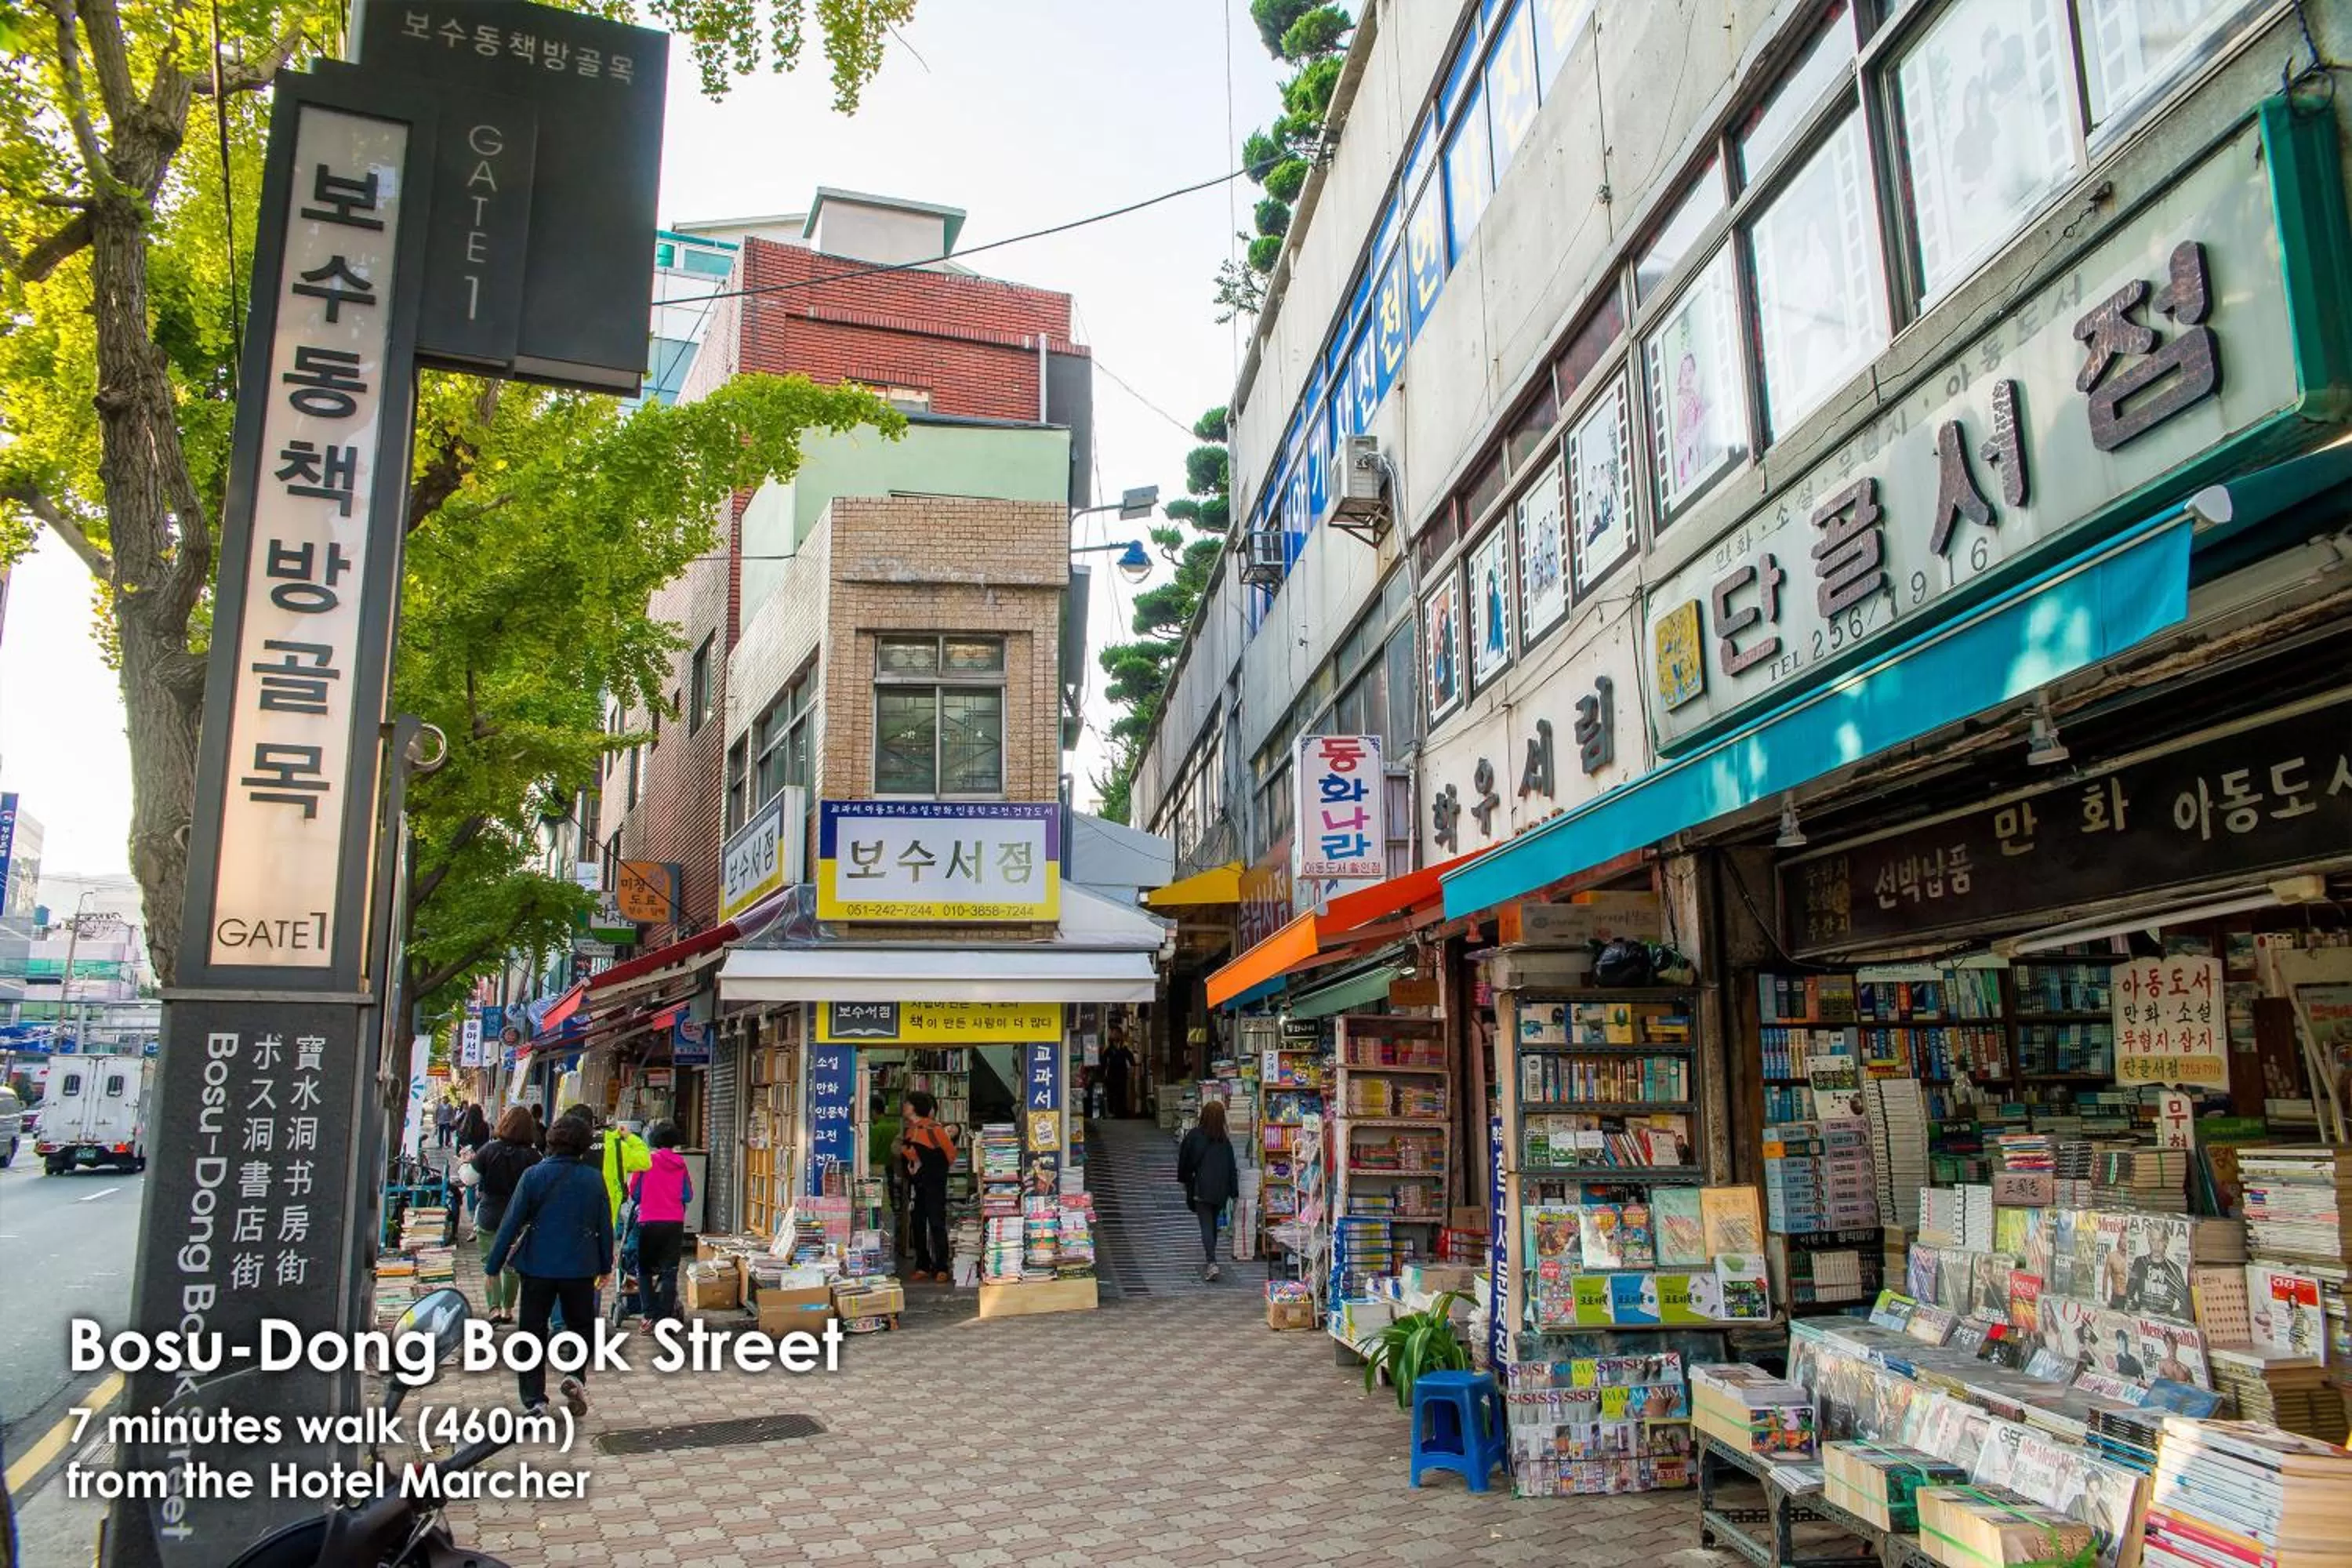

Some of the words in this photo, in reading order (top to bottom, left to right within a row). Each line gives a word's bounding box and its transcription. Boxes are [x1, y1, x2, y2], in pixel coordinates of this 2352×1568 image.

[401, 11, 634, 85] 보수동책방골목
[466, 125, 503, 264] GATE
[1711, 240, 2223, 677] 단골서점
[241, 163, 384, 820] 보수동책방골목
[1768, 650, 1803, 681] TEL
[1432, 674, 1614, 854] 학우서림
[1318, 737, 1372, 861] 동화나라
[728, 823, 775, 898] 보수서점
[846, 839, 1033, 884] 보수서점
[1305, 862, 1347, 874] 아동도서
[216, 913, 327, 950] GATE1
[2122, 963, 2212, 1003] 아동도서
[837, 1005, 891, 1018] 보수서점
[816, 1056, 839, 1071] 소설
[816, 1081, 839, 1095] 만화
[1034, 1045, 1053, 1109] 교과서
[2122, 1058, 2178, 1080] 단골서점
[815, 1105, 849, 1120] 인문학
[815, 1129, 837, 1142] 고전
[178, 1031, 239, 1274] Bosu-Dong
[230, 1034, 284, 1291] ボス洞書店街
[275, 1035, 327, 1287] 寶水洞书房街
